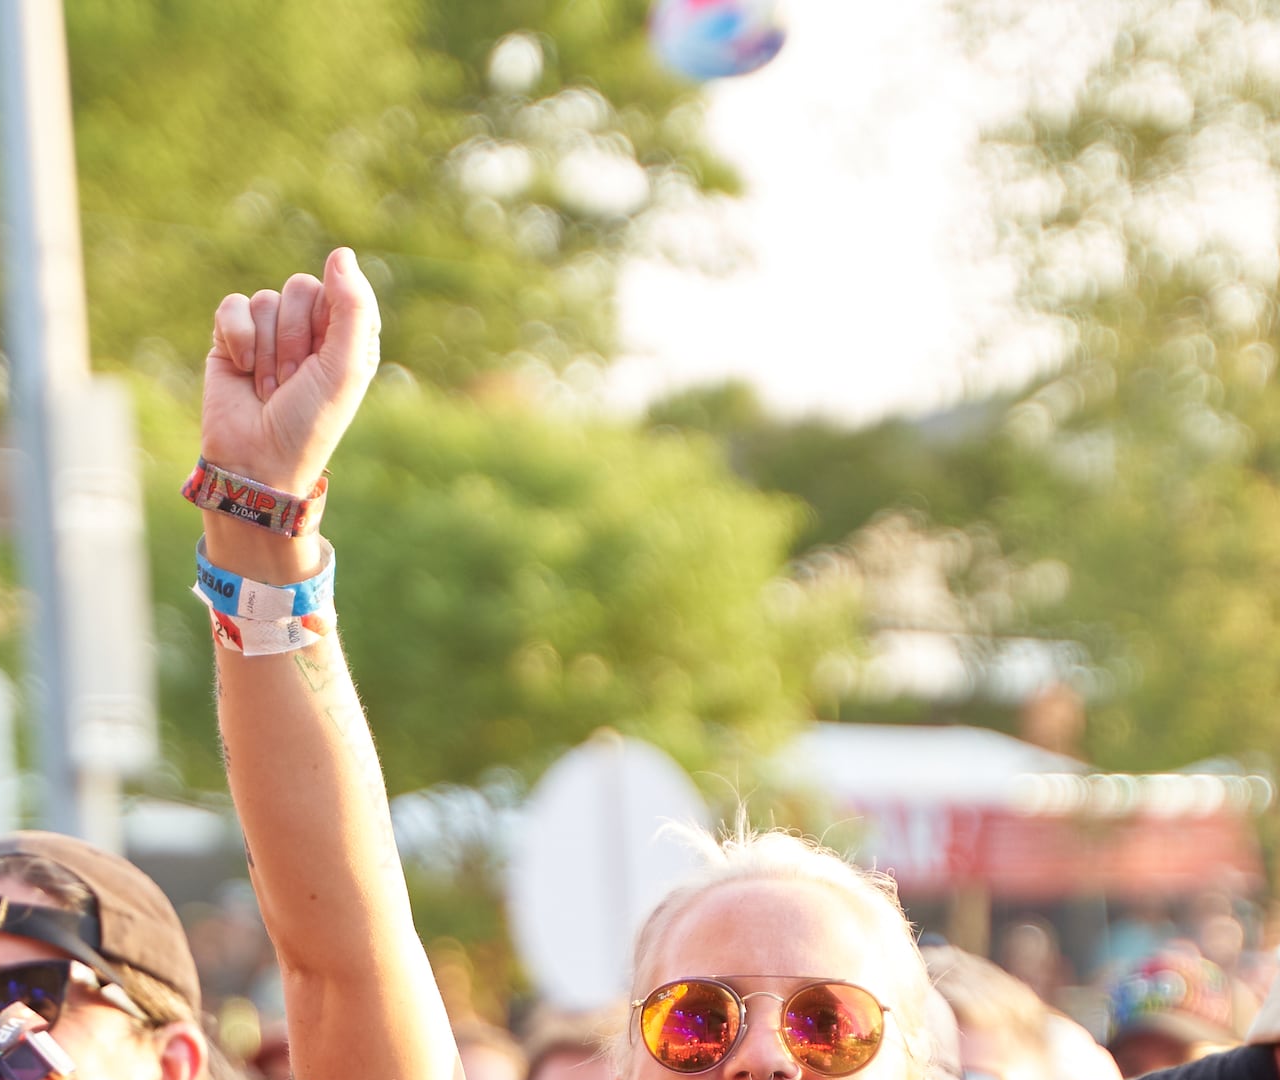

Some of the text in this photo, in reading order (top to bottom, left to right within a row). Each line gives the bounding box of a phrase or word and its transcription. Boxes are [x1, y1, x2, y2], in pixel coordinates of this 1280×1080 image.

[225, 479, 276, 510] VIP
[230, 504, 261, 520] 3/DAY
[202, 571, 236, 598] OVER
